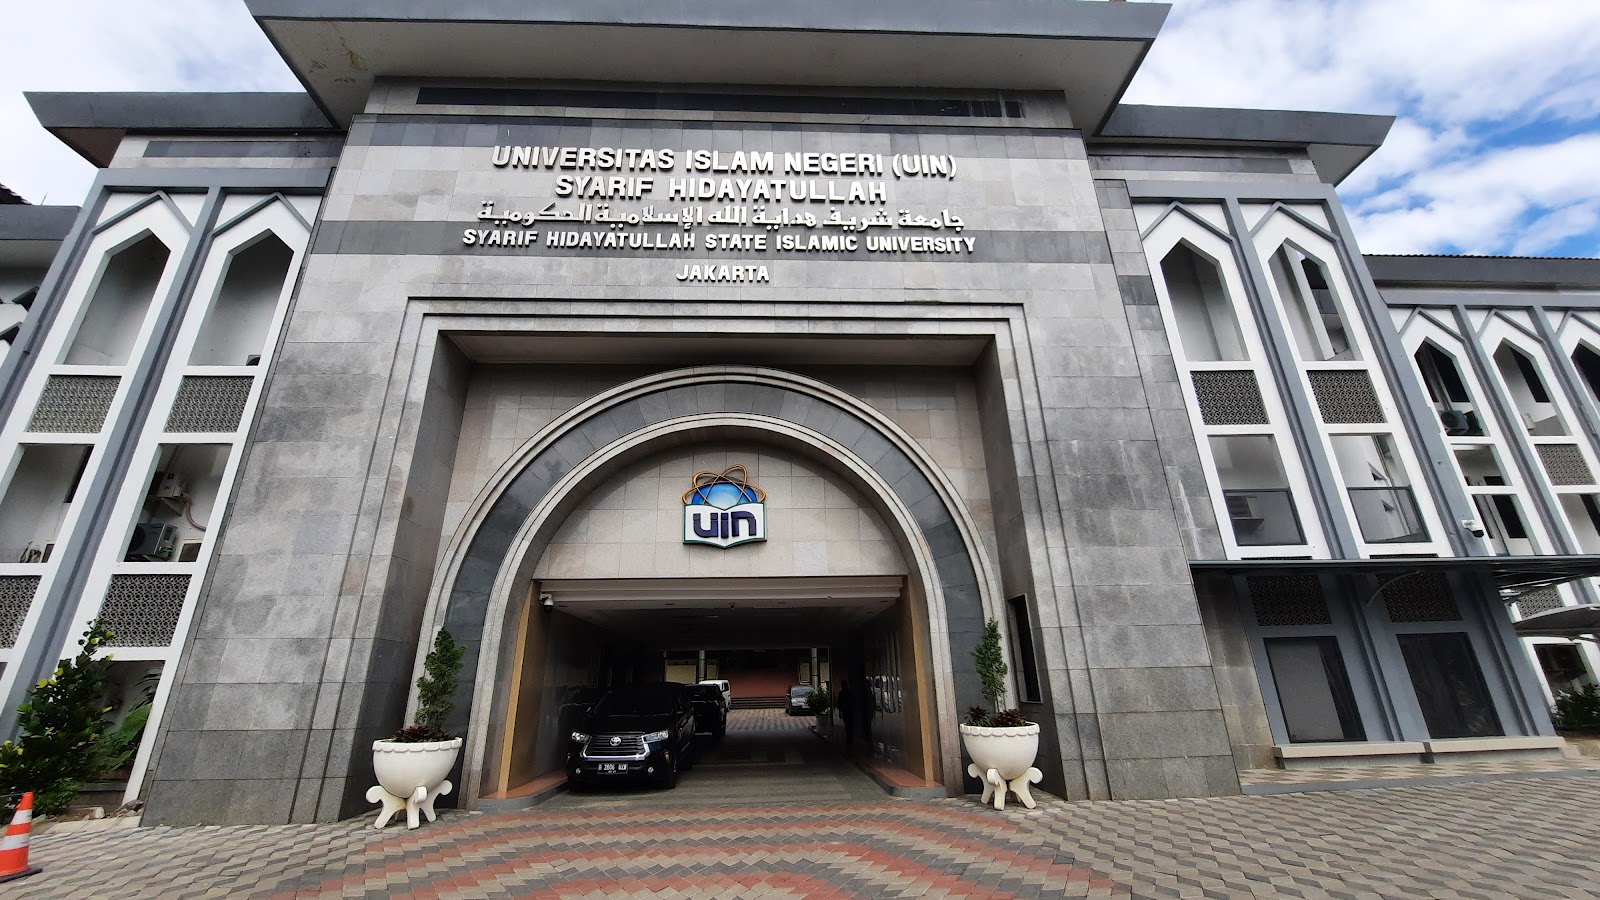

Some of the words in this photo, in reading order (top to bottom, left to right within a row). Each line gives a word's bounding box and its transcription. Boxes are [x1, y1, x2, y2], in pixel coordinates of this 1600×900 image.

[491, 145, 675, 171] UNIVERSITAS
[684, 149, 774, 174] ISLAM
[784, 152, 884, 177] NEGERI
[892, 154, 958, 180] (UIN)
[555, 175, 654, 200] SYARIF
[669, 178, 887, 203] HIDAYATULLAH
[476, 200, 593, 226] الحكومية
[594, 202, 703, 230] الإسلامية
[707, 204, 747, 226] الله
[751, 205, 817, 231] هداية
[822, 206, 893, 232] شريف
[898, 208, 965, 232] جامعة
[462, 228, 538, 247] SYARIF
[546, 230, 696, 250] HIDAYATULLAH
[705, 232, 767, 251] STATE
[775, 235, 858, 252] ISLAMIC
[866, 236, 976, 254] UNIVERSITY
[676, 264, 770, 283] JAKARTA
